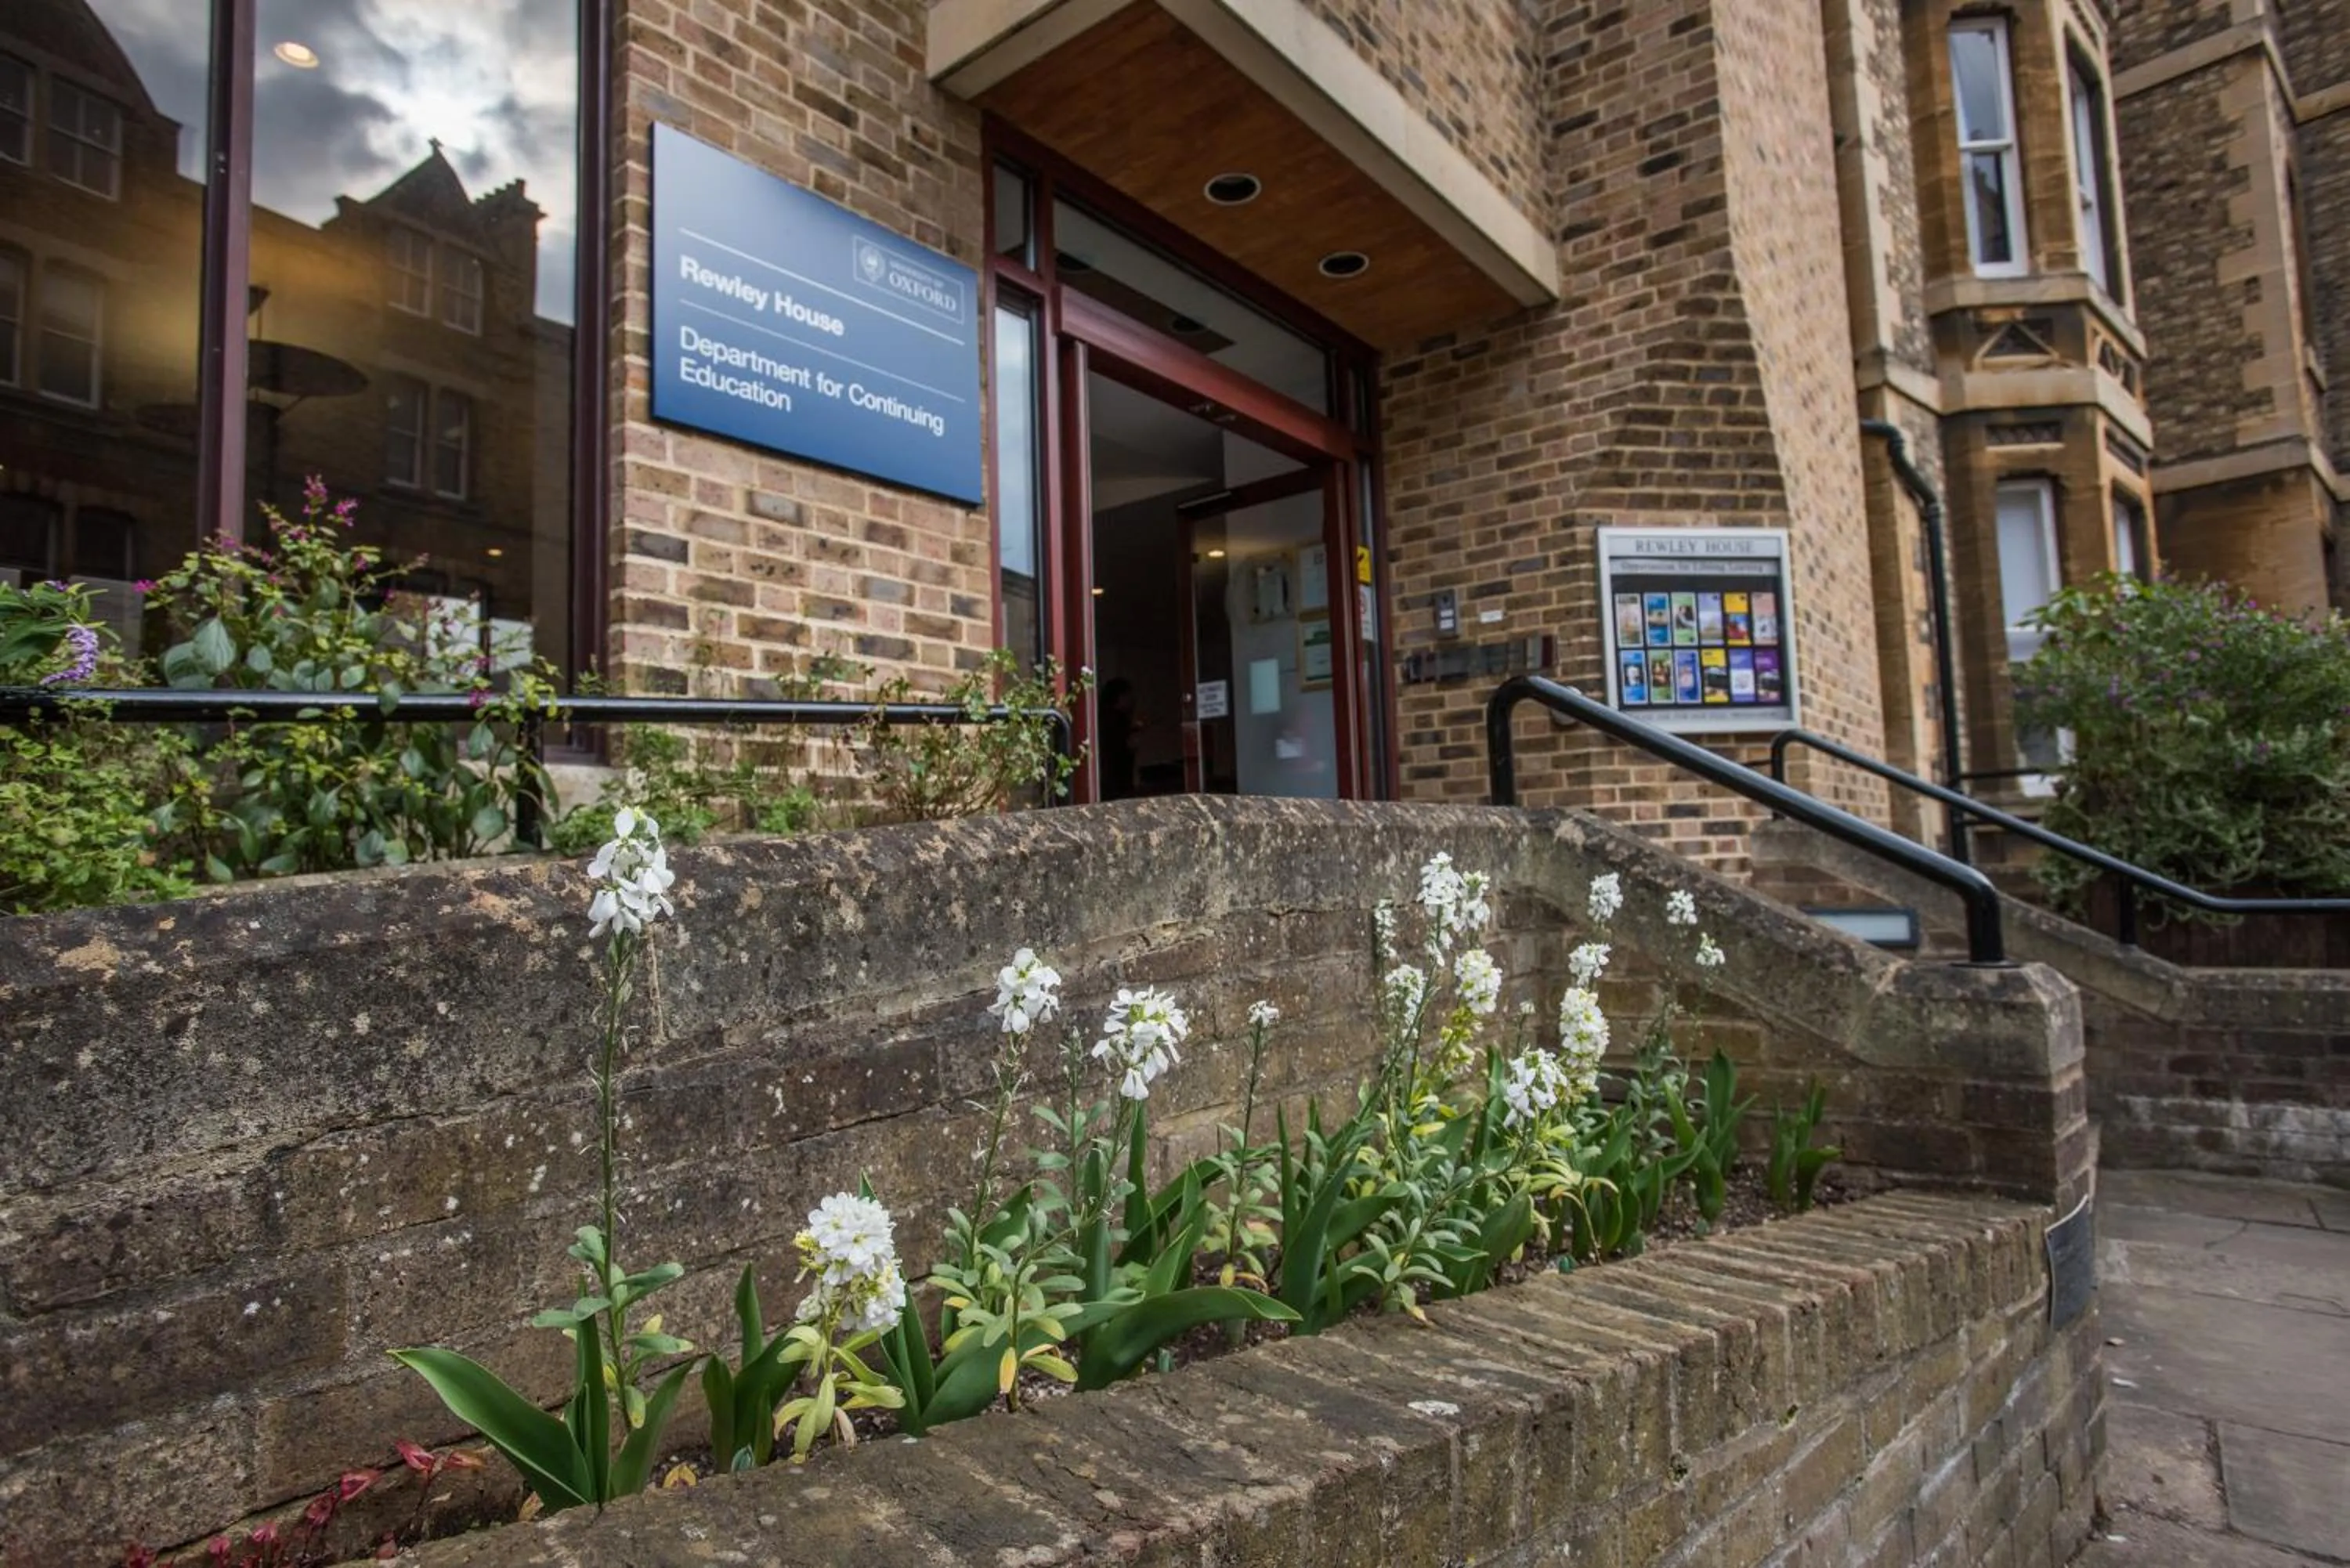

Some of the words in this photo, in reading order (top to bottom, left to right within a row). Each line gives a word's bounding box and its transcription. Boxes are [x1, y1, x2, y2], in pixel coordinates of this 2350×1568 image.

[679, 254, 768, 312] Rewley
[774, 291, 845, 337] House
[889, 271, 956, 312] OXFORD
[679, 325, 812, 389] Department
[816, 371, 844, 399] for
[848, 382, 945, 437] Continuing
[679, 356, 792, 413] Education
[1634, 539, 1697, 553] REWLEY
[1705, 540, 1755, 553] HOUSE
